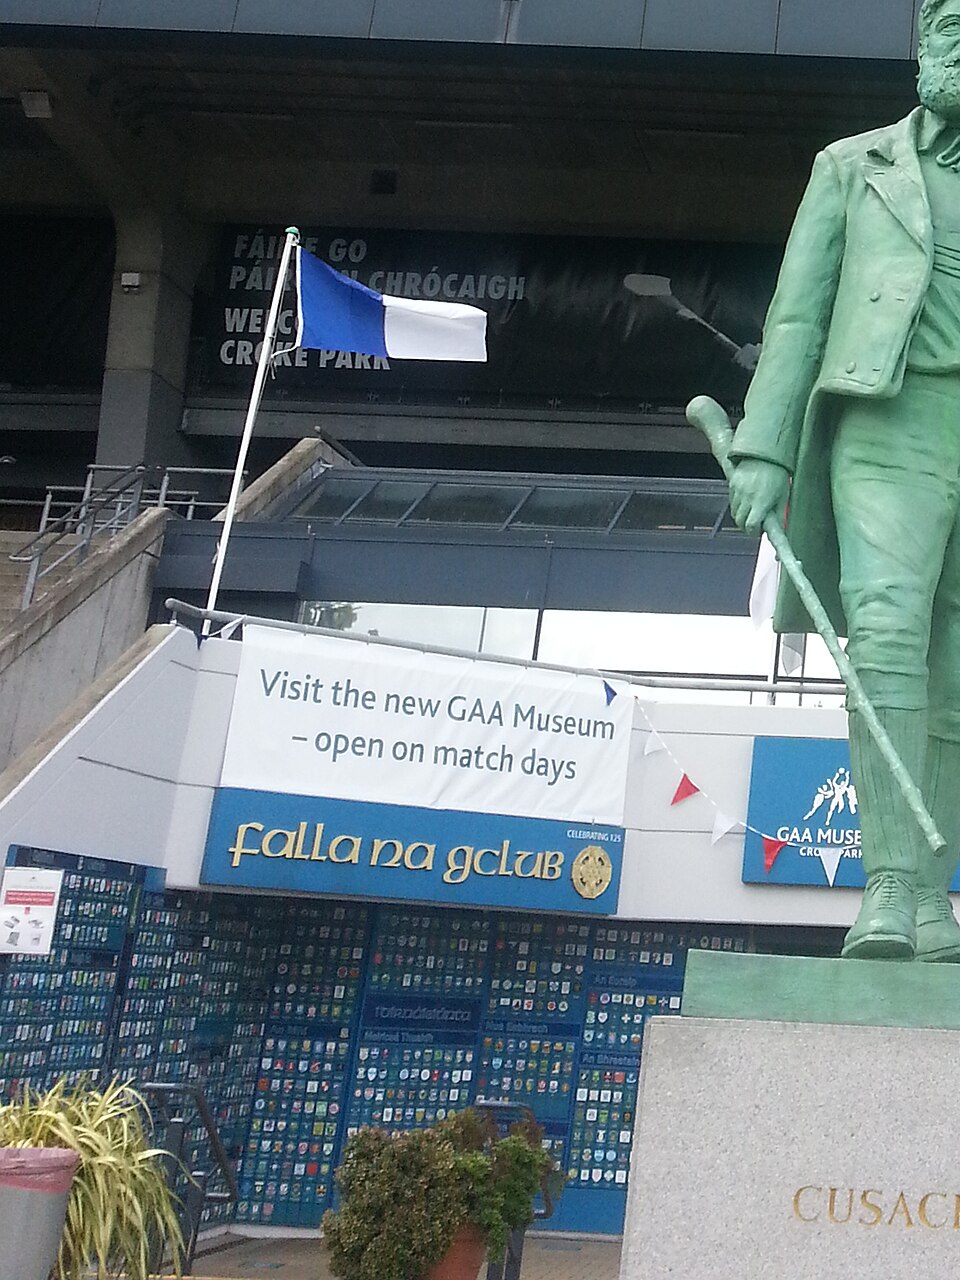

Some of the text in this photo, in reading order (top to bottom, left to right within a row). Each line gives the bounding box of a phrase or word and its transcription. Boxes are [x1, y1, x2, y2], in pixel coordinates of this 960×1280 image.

[233, 228, 368, 263] FÁIE GO
[369, 266, 526, 300] CHRÓCAIGH
[260, 669, 615, 740] Visit the new GAA Museum
[314, 732, 384, 762] open
[392, 740, 424, 763] on
[433, 745, 513, 772] match
[521, 748, 577, 786] days
[566, 829, 622, 843] CELEBRATING 125
[776, 826, 862, 845] GAA MUSE
[369, 838, 437, 871] na
